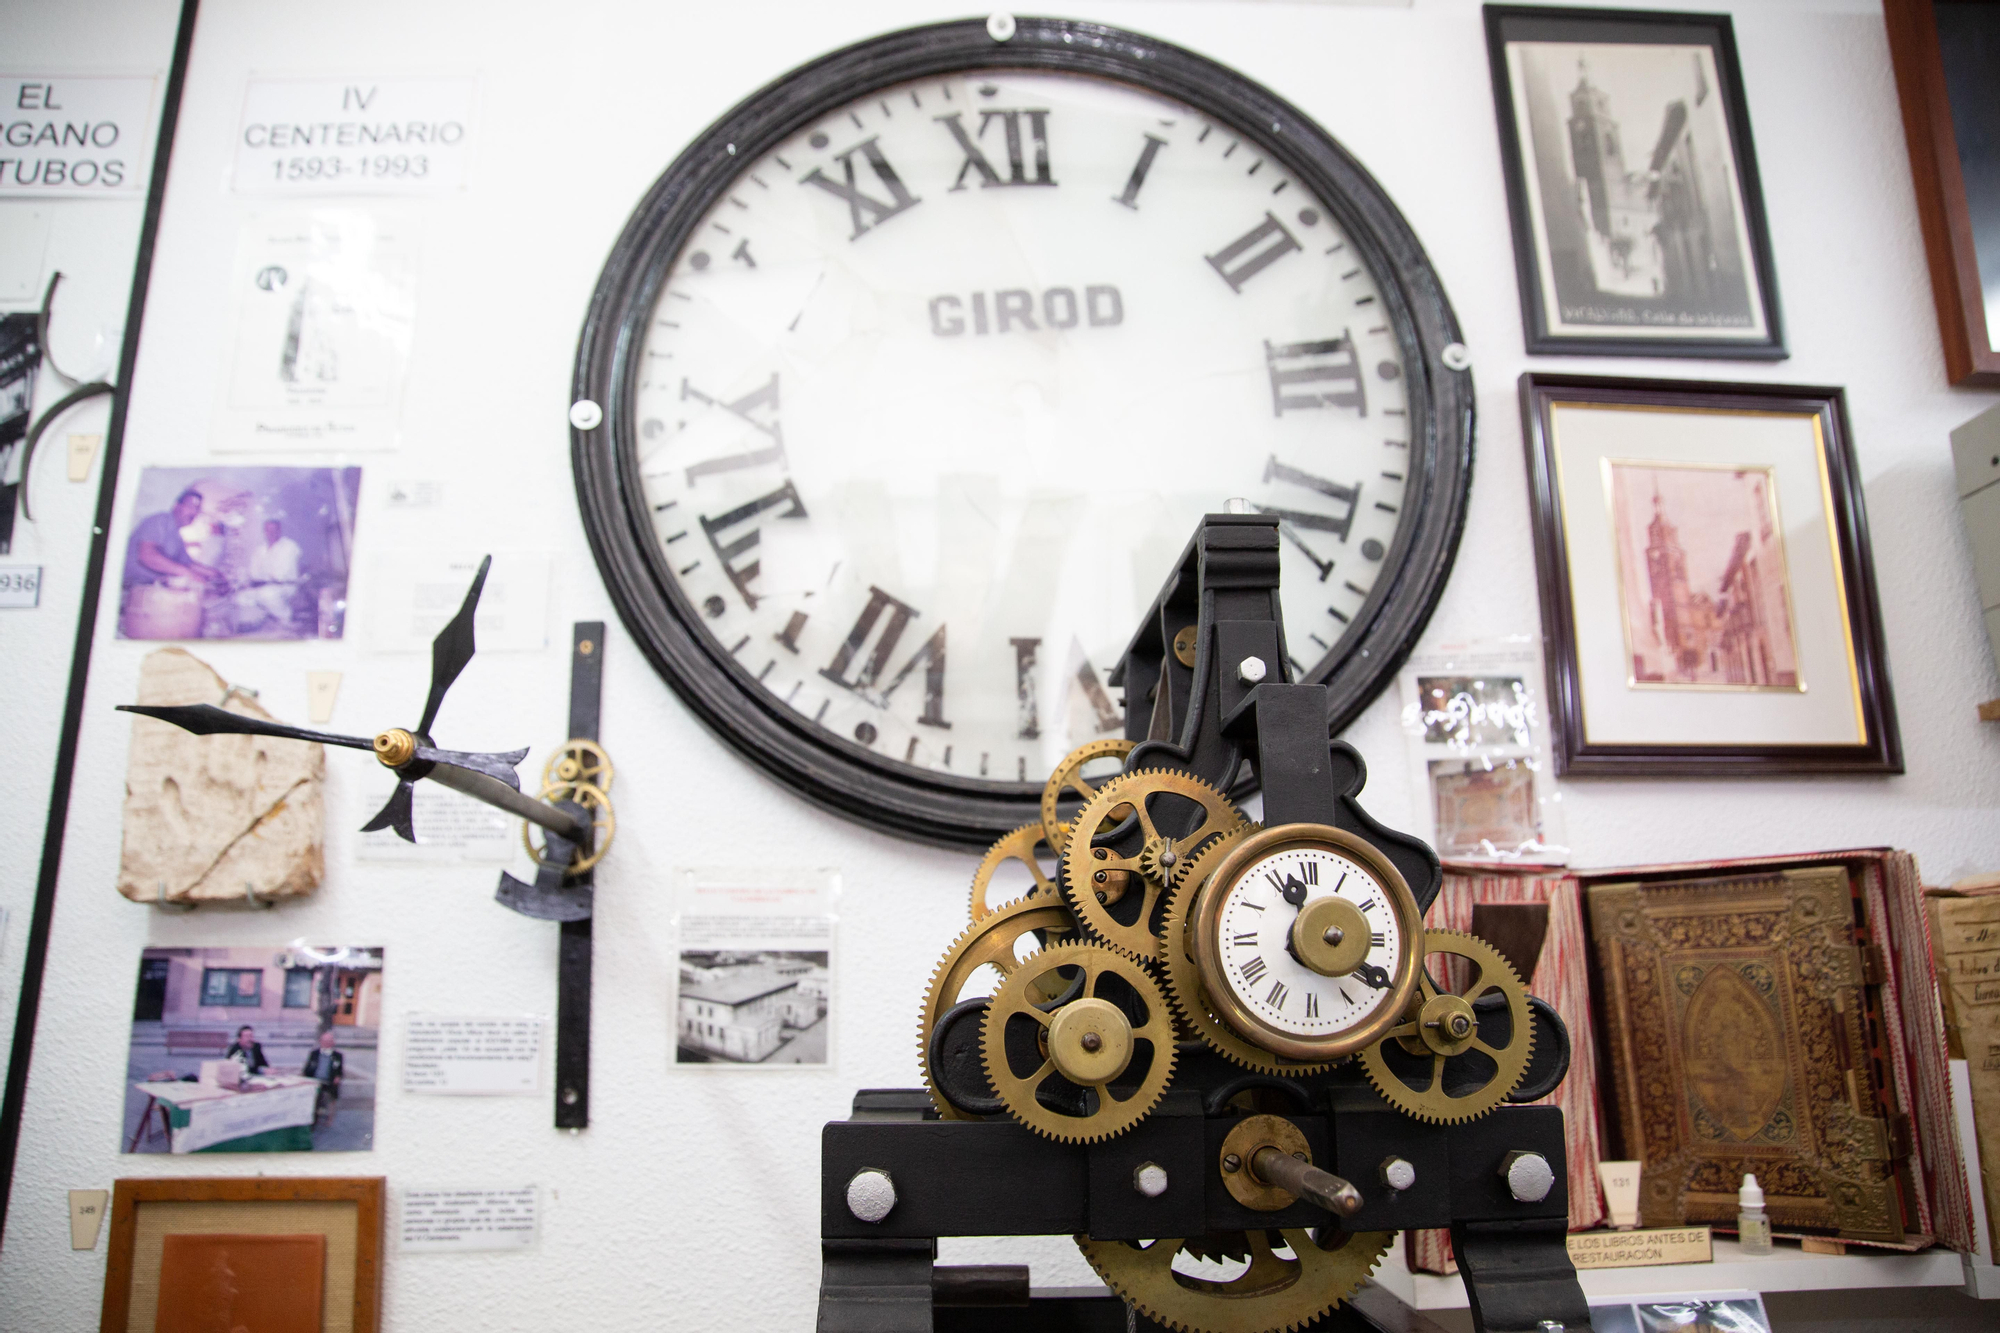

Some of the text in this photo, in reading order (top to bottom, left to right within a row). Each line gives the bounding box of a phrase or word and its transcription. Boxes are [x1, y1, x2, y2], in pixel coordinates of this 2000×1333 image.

[17, 82, 62, 110] EL
[342, 84, 377, 110] IV
[0, 121, 119, 148] GANO
[244, 120, 464, 148] CENTENARIO
[932, 108, 1058, 193] XII
[273, 153, 428, 181] 1593-1993
[1111, 132, 1169, 211] I
[797, 133, 923, 242] XI
[1204, 210, 1304, 295] II
[928, 284, 1125, 338] GIROD
[1263, 327, 1368, 418] III
[1334, 872, 1349, 893] I
[1240, 896, 1267, 919] X
[1233, 929, 1259, 948] IX
[1239, 956, 1269, 987] VIII
[1266, 980, 1290, 1011] VII
[1305, 993, 1320, 1018] VI
[1339, 986, 1355, 1009] V
[1577, 1238, 1600, 1250] LOS
[1602, 1234, 1644, 1248] LIBROS
[1647, 1232, 1686, 1245] ANTES
[1688, 1230, 1705, 1243] DE
